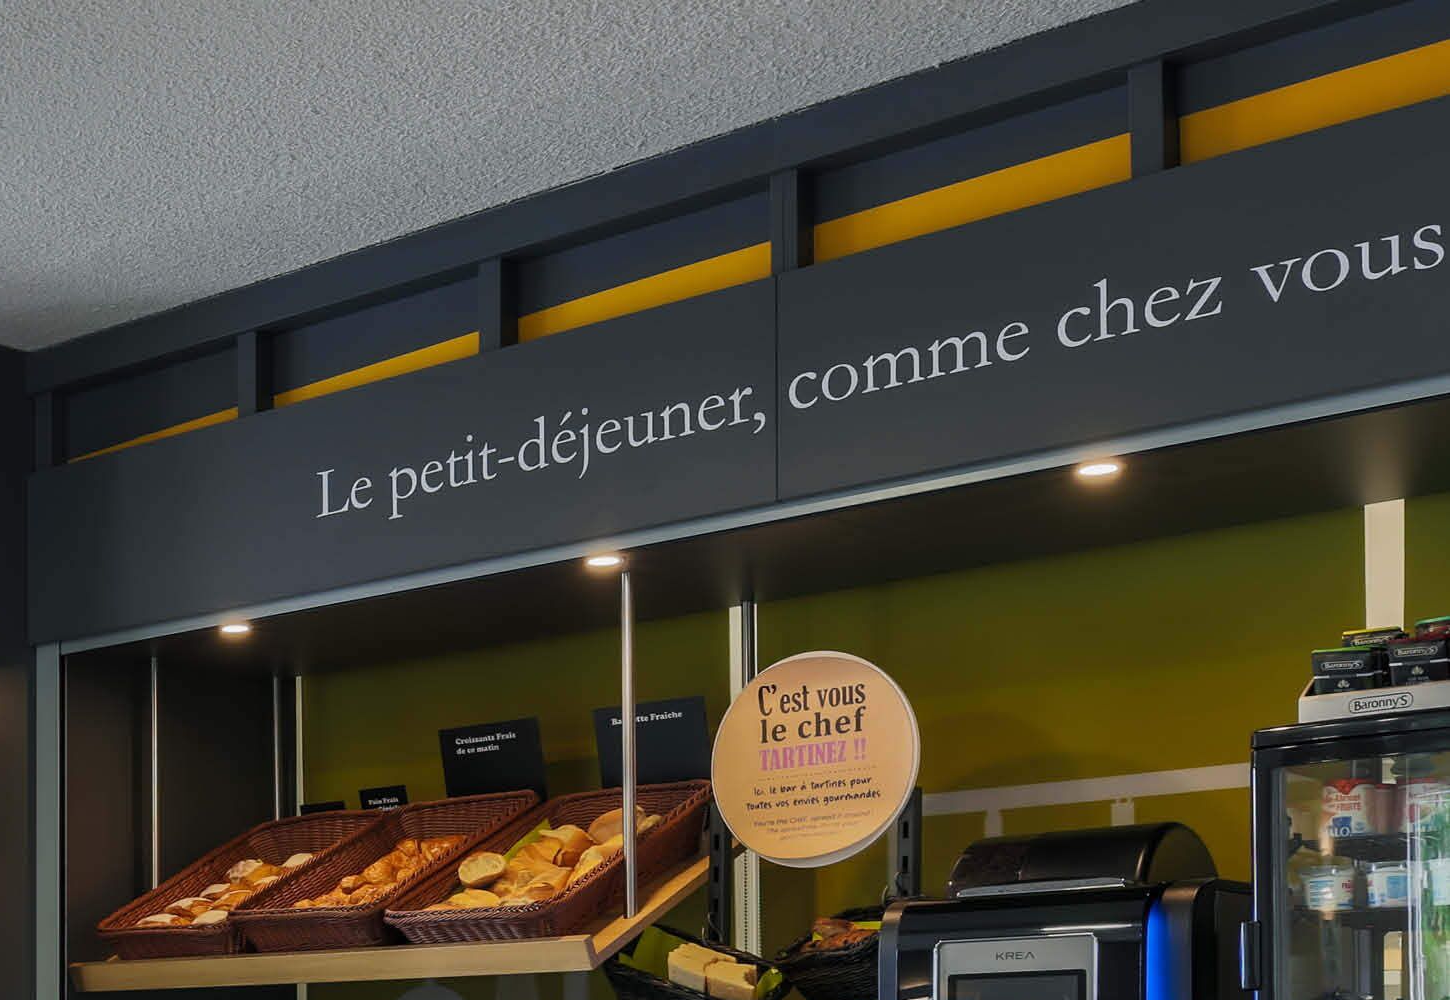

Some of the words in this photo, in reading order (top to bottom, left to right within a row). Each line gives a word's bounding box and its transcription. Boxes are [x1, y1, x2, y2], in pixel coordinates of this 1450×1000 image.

[315, 469, 373, 518] Le
[388, 383, 766, 520] petit-déjeuner,
[788, 319, 1030, 411] comme
[1057, 277, 1223, 348] chez
[1250, 224, 1445, 303] vous
[758, 684, 810, 716] C'est
[817, 683, 866, 709] vous
[760, 719, 787, 744] le
[797, 706, 866, 739] chef
[454, 734, 495, 746] Croissants
[496, 732, 516, 742] Frais
[456, 746, 466, 756] de
[476, 744, 500, 754] matin
[758, 740, 847, 771] TARTINEZ
[780, 784, 796, 794] bar
[850, 776, 872, 788] pour
[775, 800, 790, 808] vos
[793, 796, 820, 807] envies
[823, 789, 882, 806] gourmandes
[995, 951, 1035, 961] KREA
